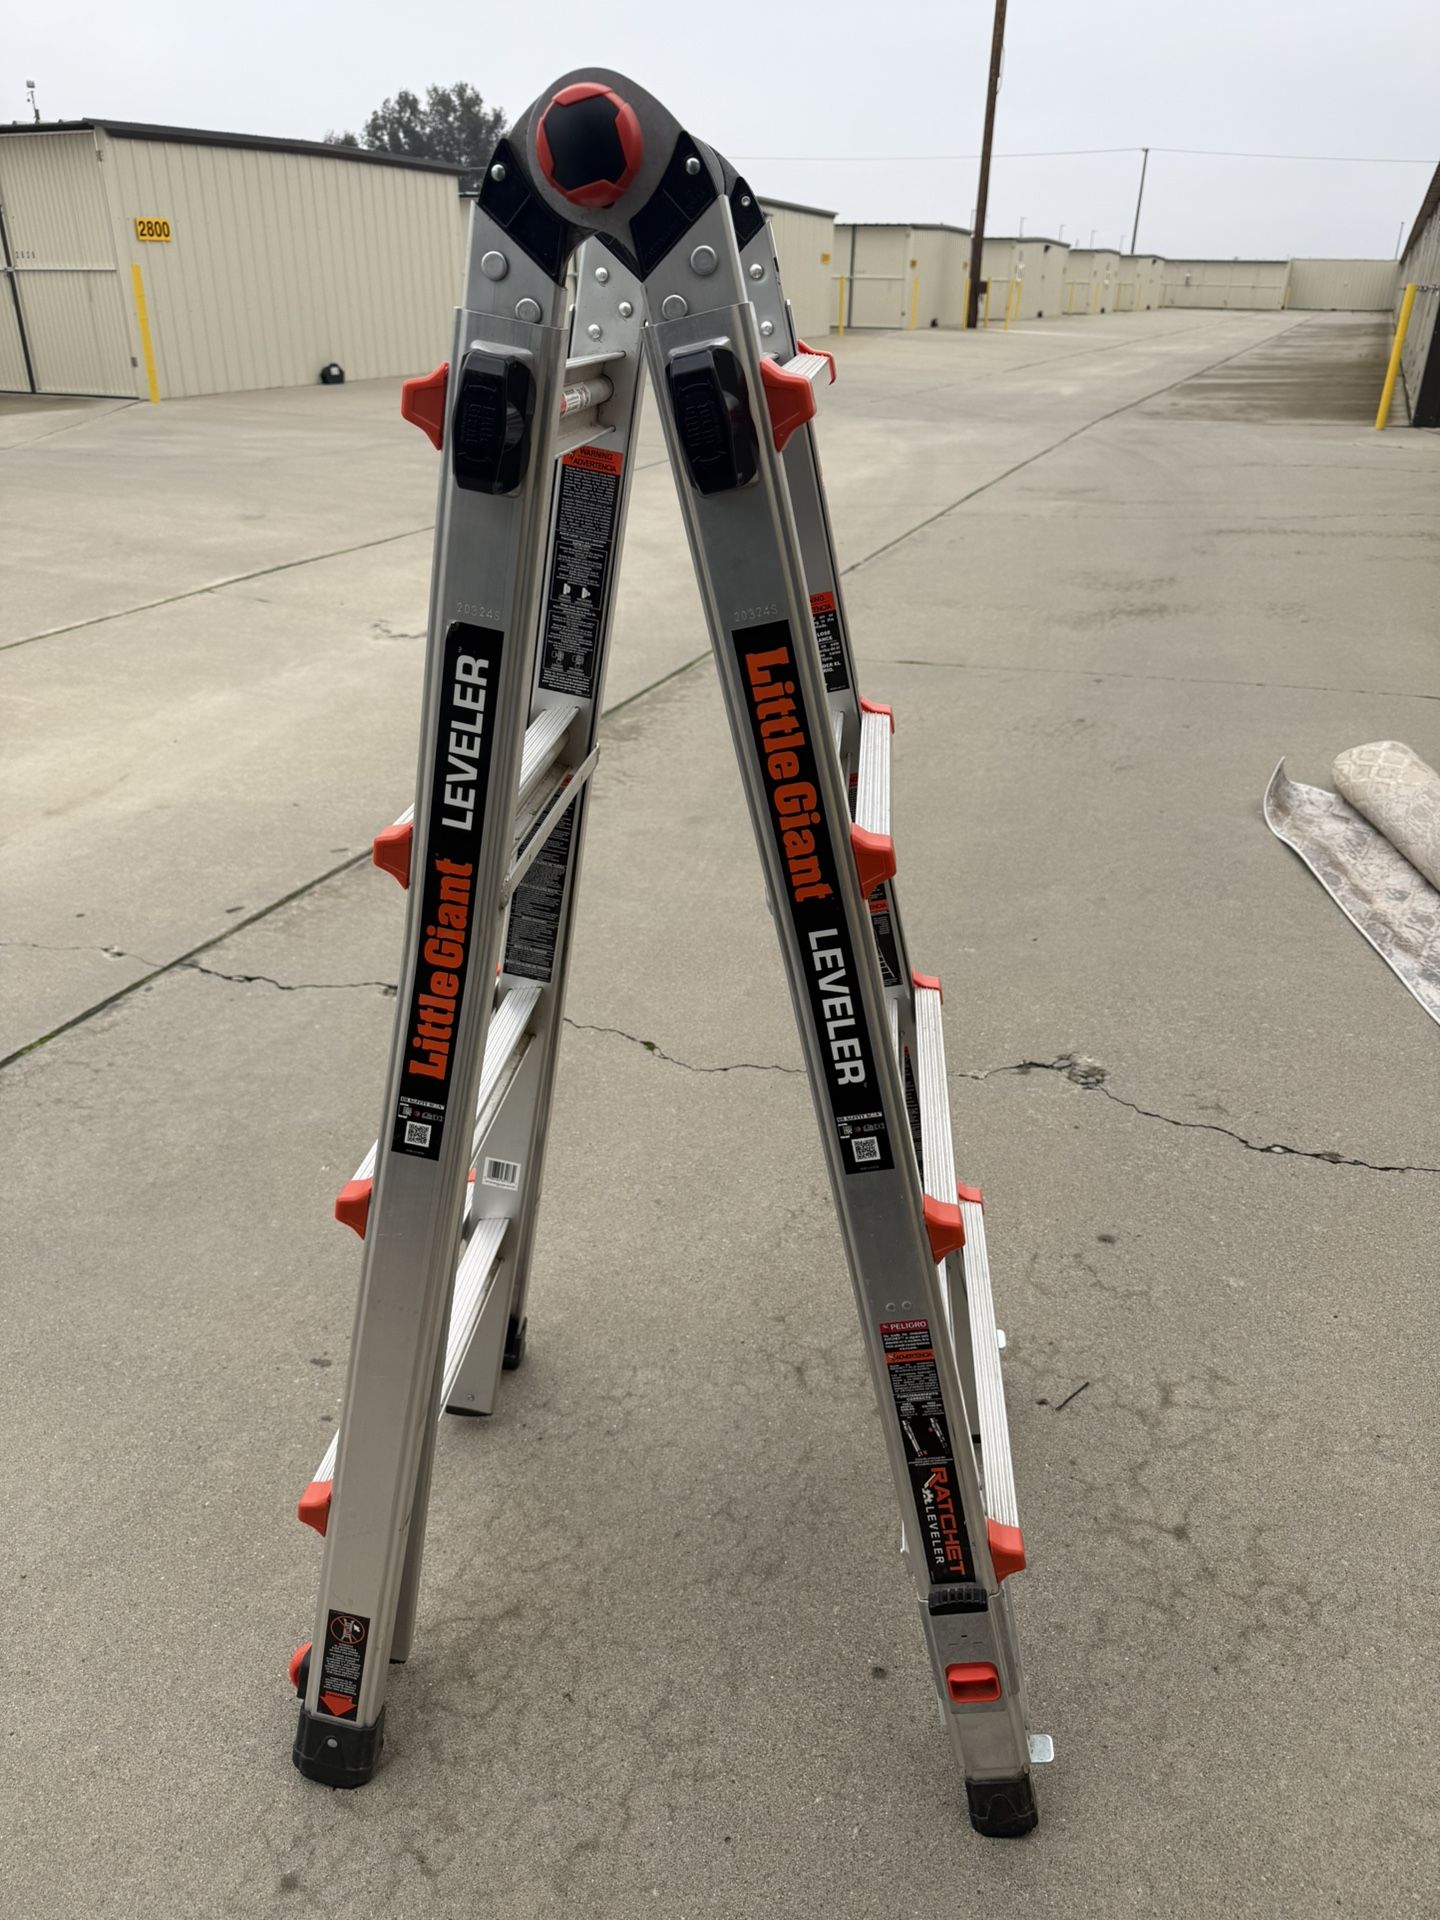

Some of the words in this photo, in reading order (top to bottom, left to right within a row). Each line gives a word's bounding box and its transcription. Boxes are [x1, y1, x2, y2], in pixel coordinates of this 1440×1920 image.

[138, 220, 170, 238] 2800
[573, 457, 617, 471] ADVERTENCIA
[442, 654, 489, 831] LEVELER
[808, 928, 867, 1085] LEVELER
[890, 1320, 927, 1330] PELIGRO
[925, 1505, 945, 1564] LEVELER
[927, 1466, 966, 1577] RATCHET
